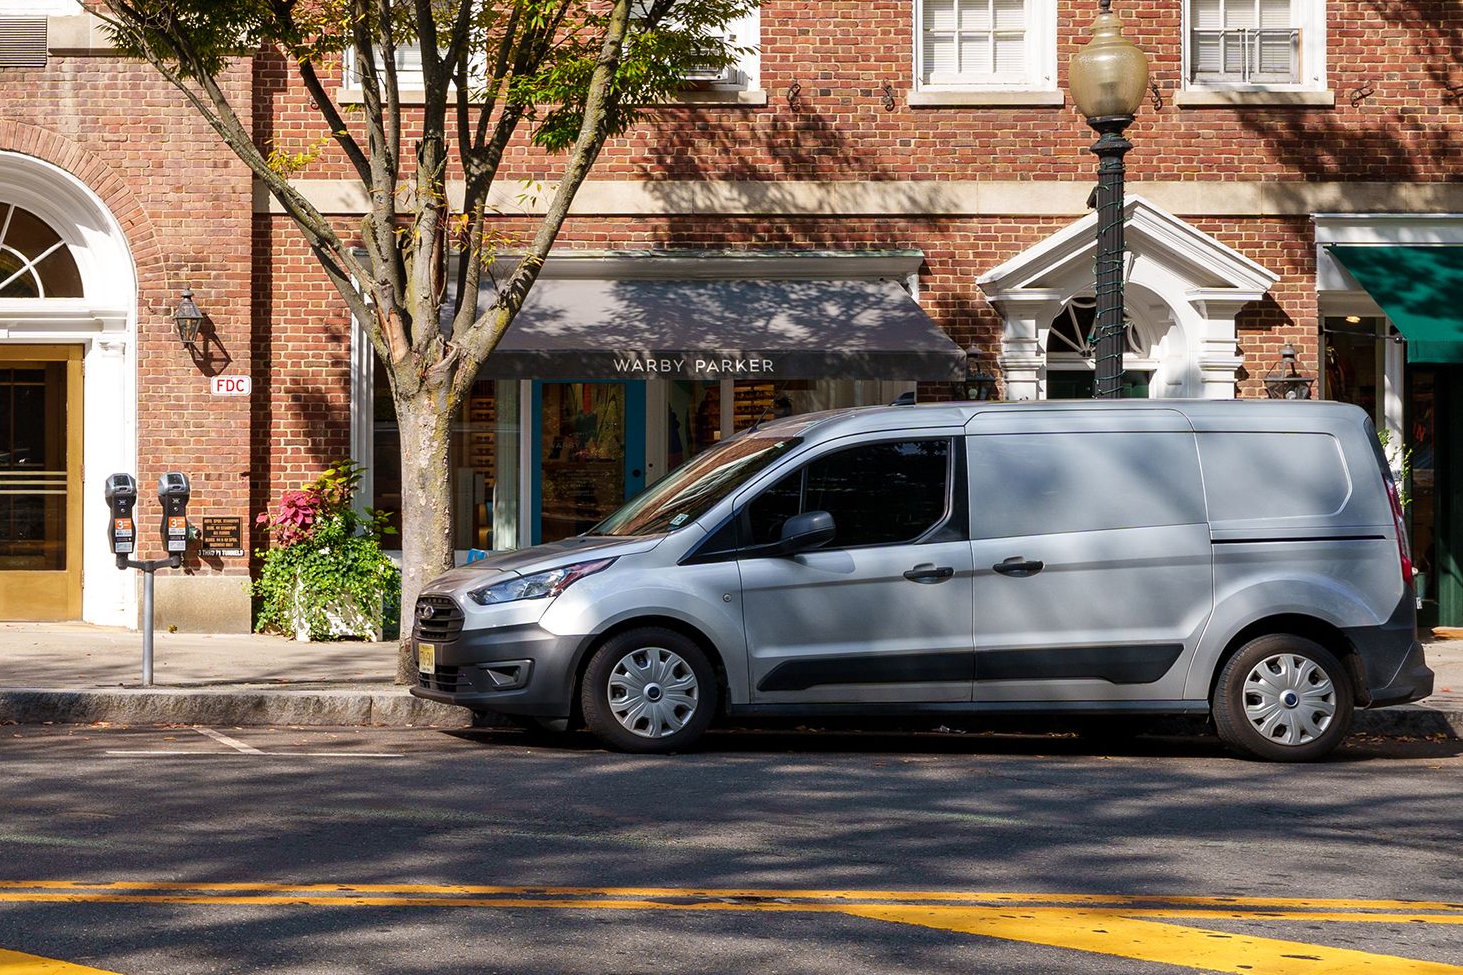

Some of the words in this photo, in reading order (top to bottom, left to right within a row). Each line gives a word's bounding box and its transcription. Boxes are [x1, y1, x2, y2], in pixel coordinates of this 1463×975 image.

[613, 358, 685, 373] WARBY
[695, 358, 775, 373] PARKER
[217, 379, 244, 392] FDC
[117, 520, 124, 529] 3
[171, 519, 178, 528] 3
